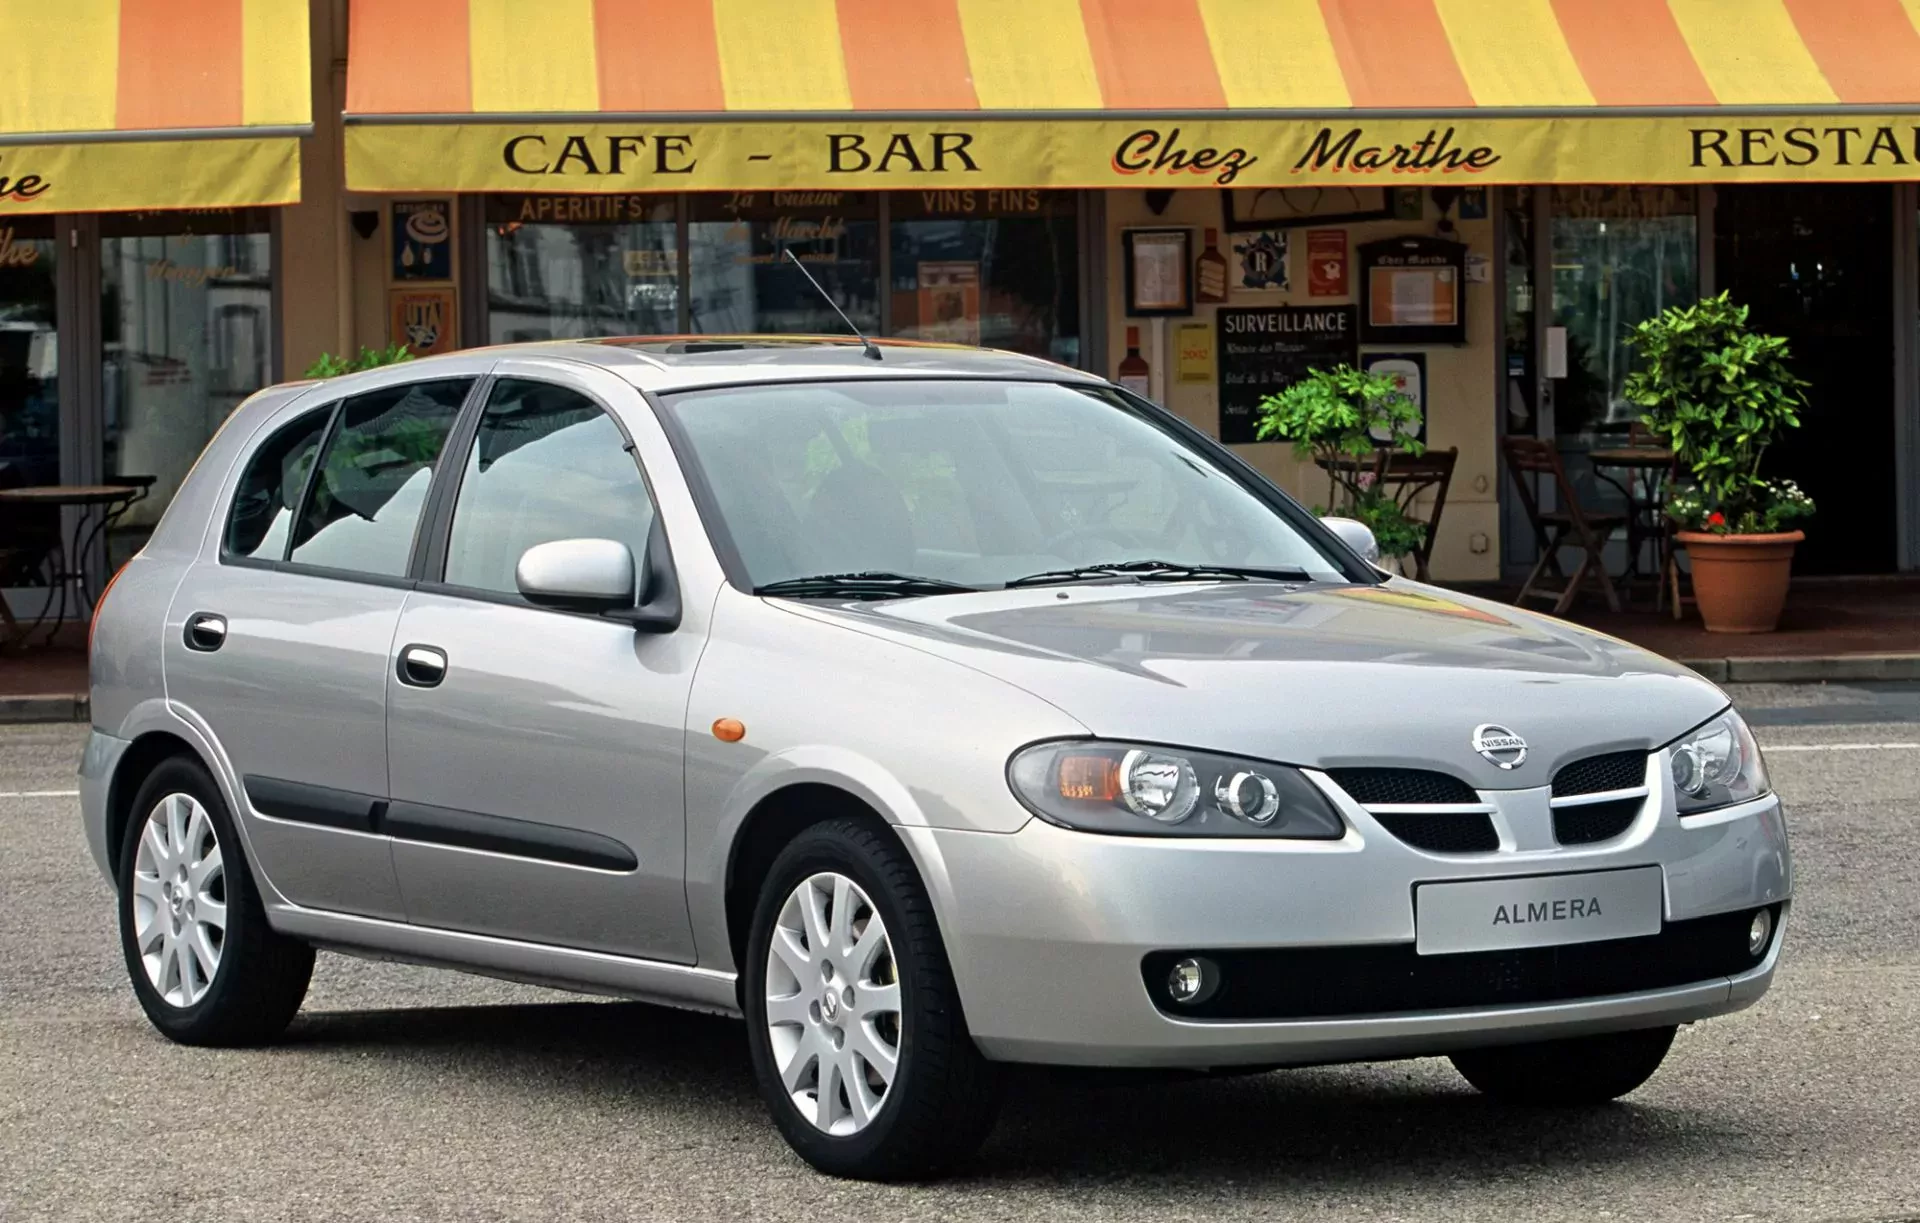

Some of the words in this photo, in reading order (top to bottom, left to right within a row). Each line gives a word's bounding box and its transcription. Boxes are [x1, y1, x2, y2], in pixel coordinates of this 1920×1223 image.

[503, 134, 697, 175] CAFE
[826, 132, 982, 174] BAR
[1112, 128, 1258, 186] Chez
[1291, 127, 1502, 174] Marthe
[520, 196, 643, 221] APERITIFS
[922, 190, 976, 213] VINS
[988, 190, 1040, 212] FINS
[1225, 312, 1348, 334] SURVEILLANCE
[1481, 738, 1524, 748] NISSAN
[1492, 896, 1602, 926] ALMERA
